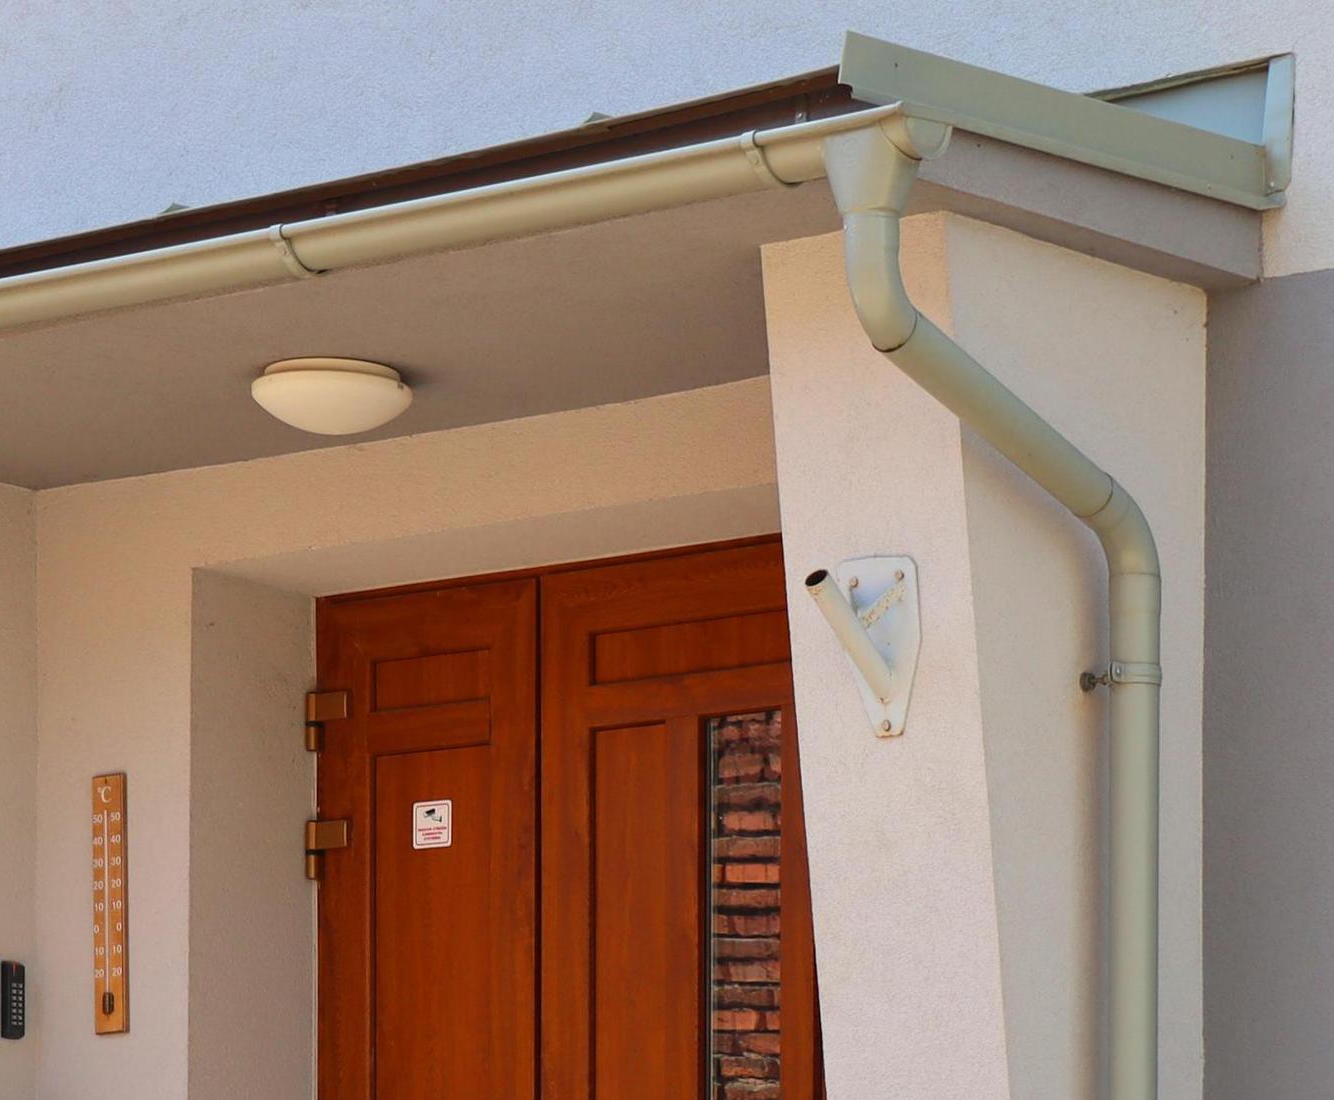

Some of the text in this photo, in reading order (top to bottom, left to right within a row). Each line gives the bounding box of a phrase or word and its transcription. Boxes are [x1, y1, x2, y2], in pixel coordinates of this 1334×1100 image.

[92, 811, 121, 824] 50 50
[93, 834, 121, 846] 40 40
[93, 856, 121, 868] 30 30
[93, 878, 121, 890] 20 20
[94, 900, 122, 912] 10 10
[93, 922, 122, 933] 0 0
[95, 944, 122, 956] 10 10
[94, 966, 122, 978] 20 20
